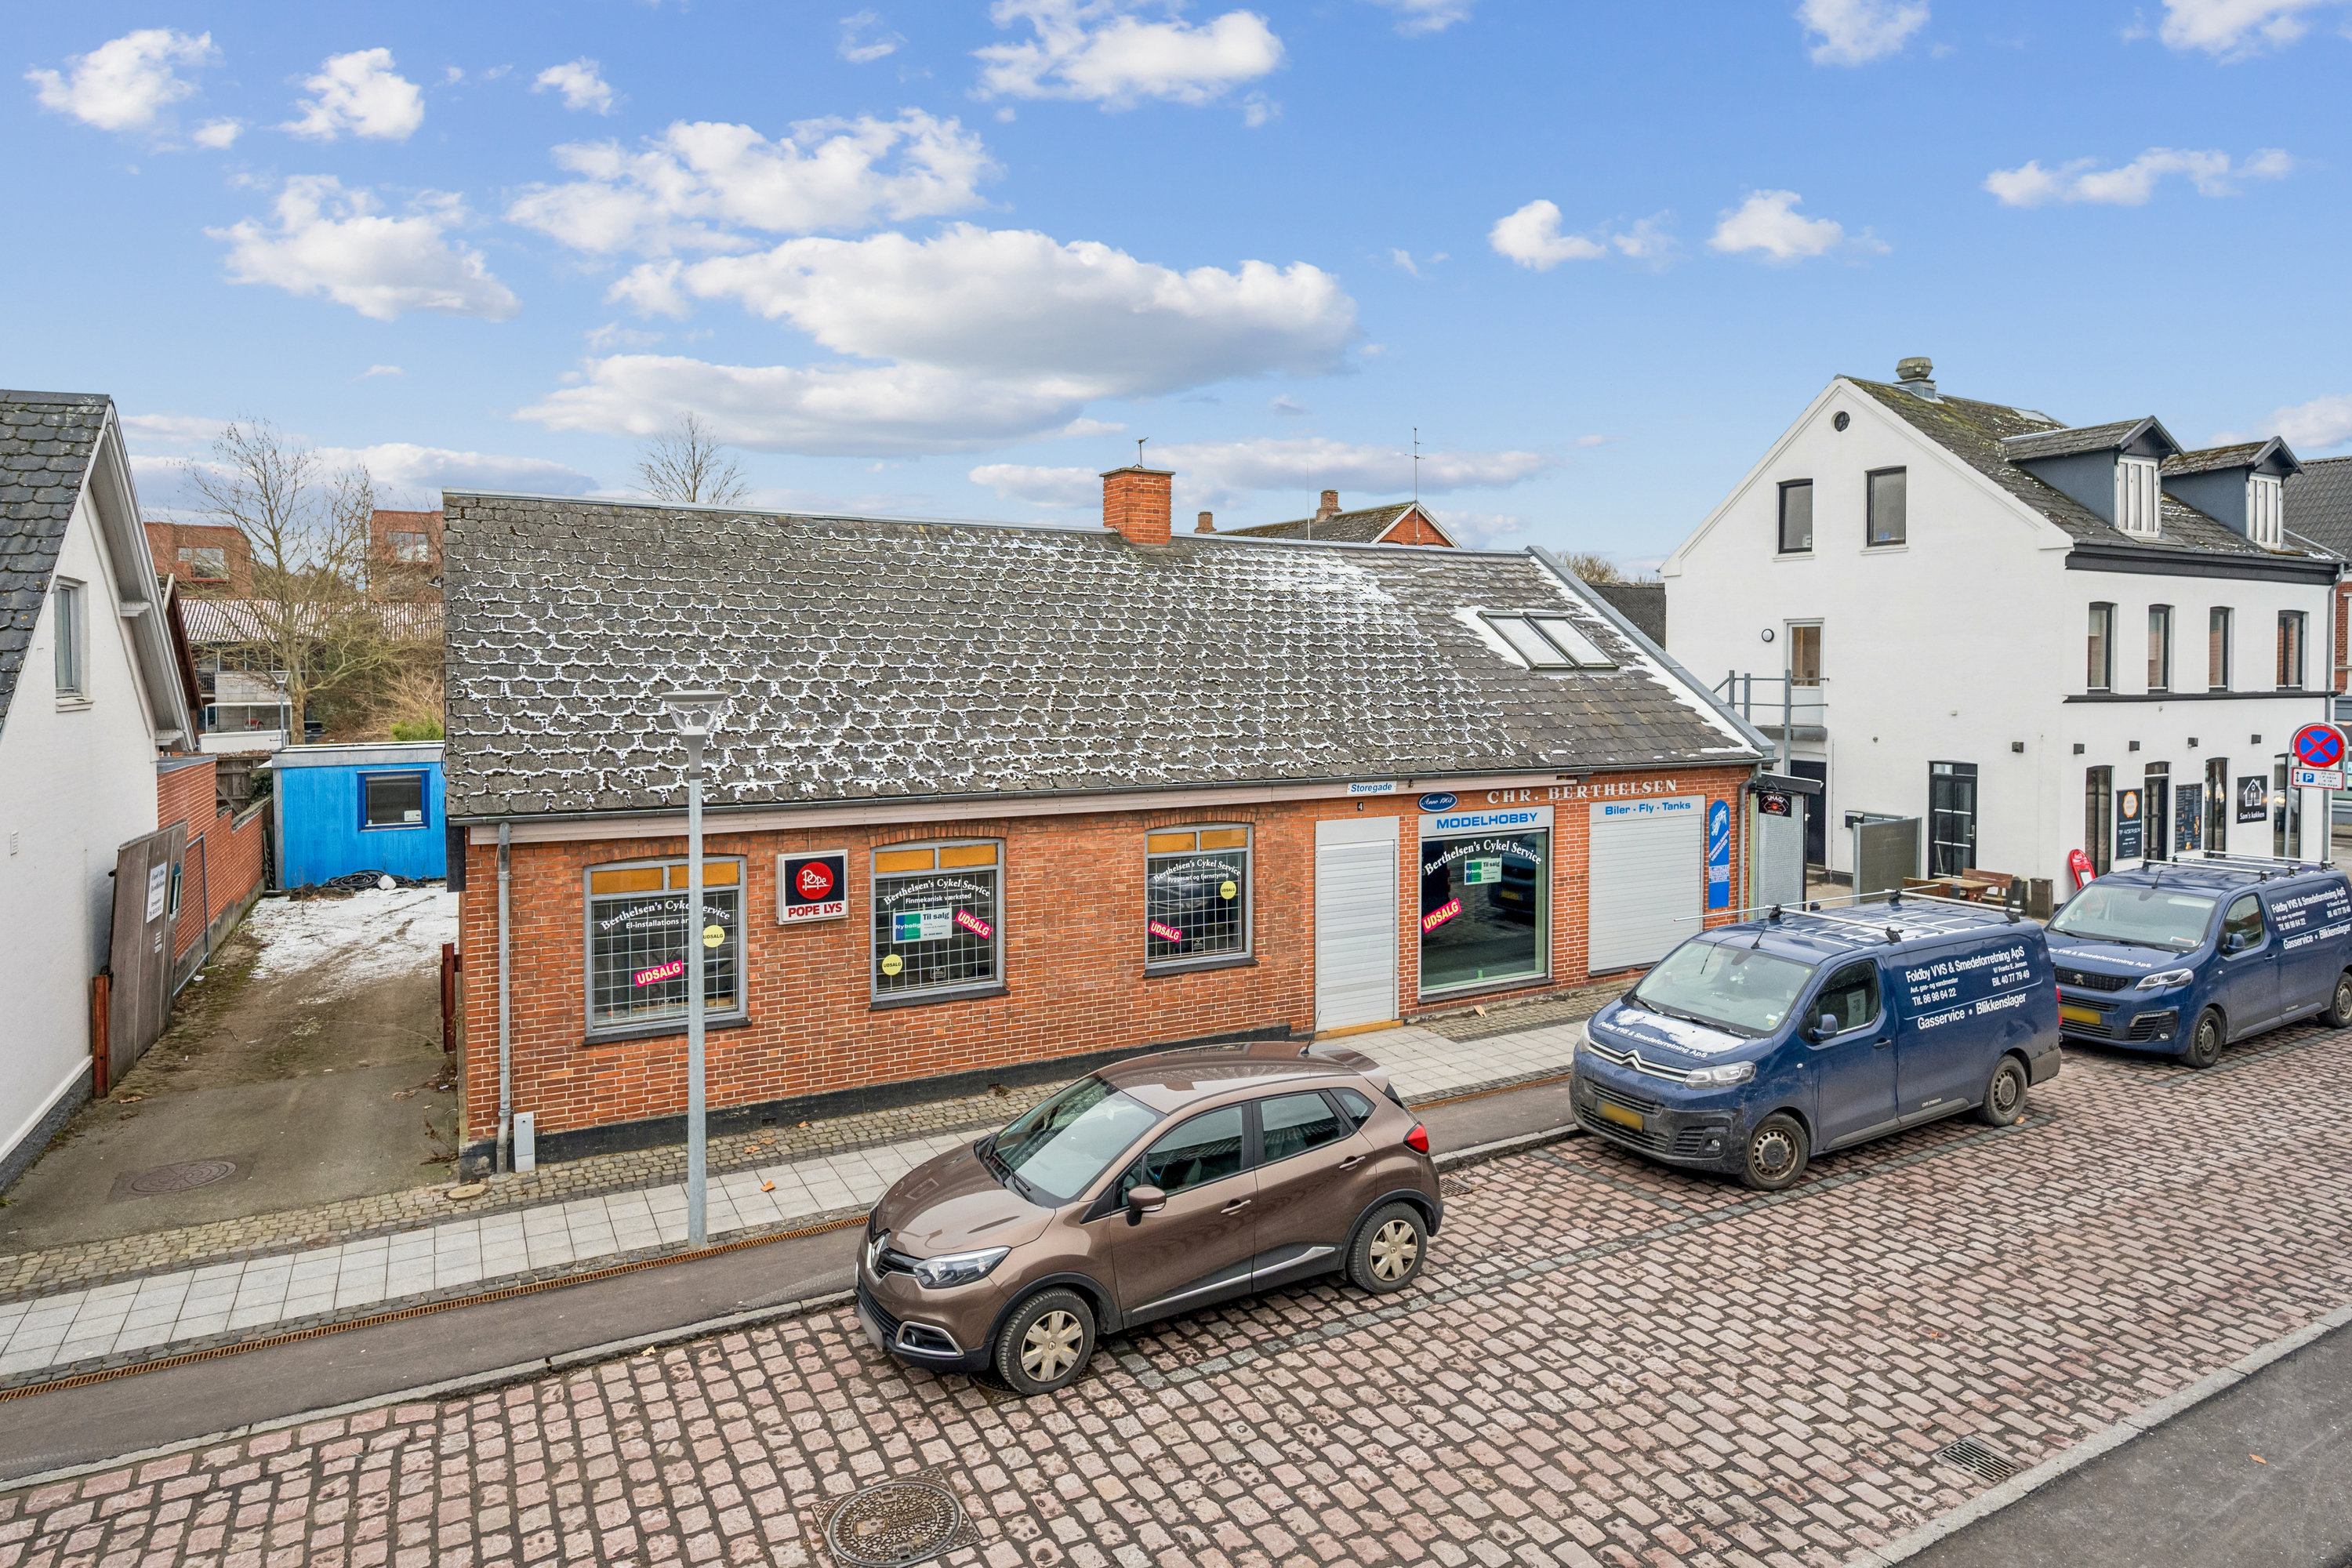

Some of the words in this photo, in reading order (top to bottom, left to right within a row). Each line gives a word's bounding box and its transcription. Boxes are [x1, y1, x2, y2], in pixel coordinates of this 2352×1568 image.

[1351, 782, 1392, 793] Storegade
[1486, 788, 1539, 804] CHR.
[1548, 779, 1677, 800] BERTHELSEN
[1358, 802, 1363, 811] 4
[1605, 805, 1631, 816] Biler
[1639, 803, 1654, 815] Fly
[1662, 800, 1691, 811] Tanks
[2240, 811, 2251, 820] Sam's
[1436, 812, 1538, 829] MODELHOBBY
[1424, 841, 1481, 876] Berthelsen's
[1483, 839, 1510, 853] Cykel
[1511, 841, 1542, 865] Service
[801, 869, 830, 891] Pope
[1153, 860, 1195, 883] Berthelsen's
[1196, 858, 1217, 869] Cykel
[1218, 860, 1241, 877] Service
[1200, 872, 1229, 880] fjernstyring
[883, 879, 935, 906] Berthelsen's
[936, 878, 961, 889] Cykel
[962, 880, 991, 898] Service
[905, 895, 943, 905] Finmekanisk
[600, 901, 662, 931] Berthelsen's
[665, 899, 689, 913] Cyke
[702, 905, 731, 920] ervice
[788, 904, 820, 918] POPE
[823, 902, 843, 914] LYS
[933, 912, 949, 920] salg
[1423, 901, 1459, 930] UDSALG
[626, 917, 680, 930] El-installations
[895, 922, 921, 931] Nybolig
[956, 912, 990, 937] UDSALG
[1150, 922, 1180, 941] UDSALG
[2283, 935, 2314, 950] Gasservice
[637, 962, 682, 985] UDSALG
[1905, 967, 1931, 983] Foldby
[1930, 962, 1948, 977] VVS
[1947, 961, 1955, 974] &
[1954, 949, 2012, 971] Smedeforretning
[2011, 946, 2025, 960] ApS
[2001, 975, 2009, 985] 40
[2008, 973, 2015, 982] 77
[2016, 971, 2023, 981] 79
[2023, 969, 2030, 979] 49
[1912, 996, 1923, 1006] Tlf.
[1922, 993, 1931, 1004] 86
[1931, 991, 1940, 1002] 98
[1940, 989, 1948, 1000] 64
[1948, 987, 1957, 998] 22
[1917, 1008, 1965, 1030] Gasservice
[1976, 993, 2027, 1015] Blikkenslager
[1634, 1032, 1690, 1054] Smedeforretning
[1690, 1049, 1708, 1058] ApS
